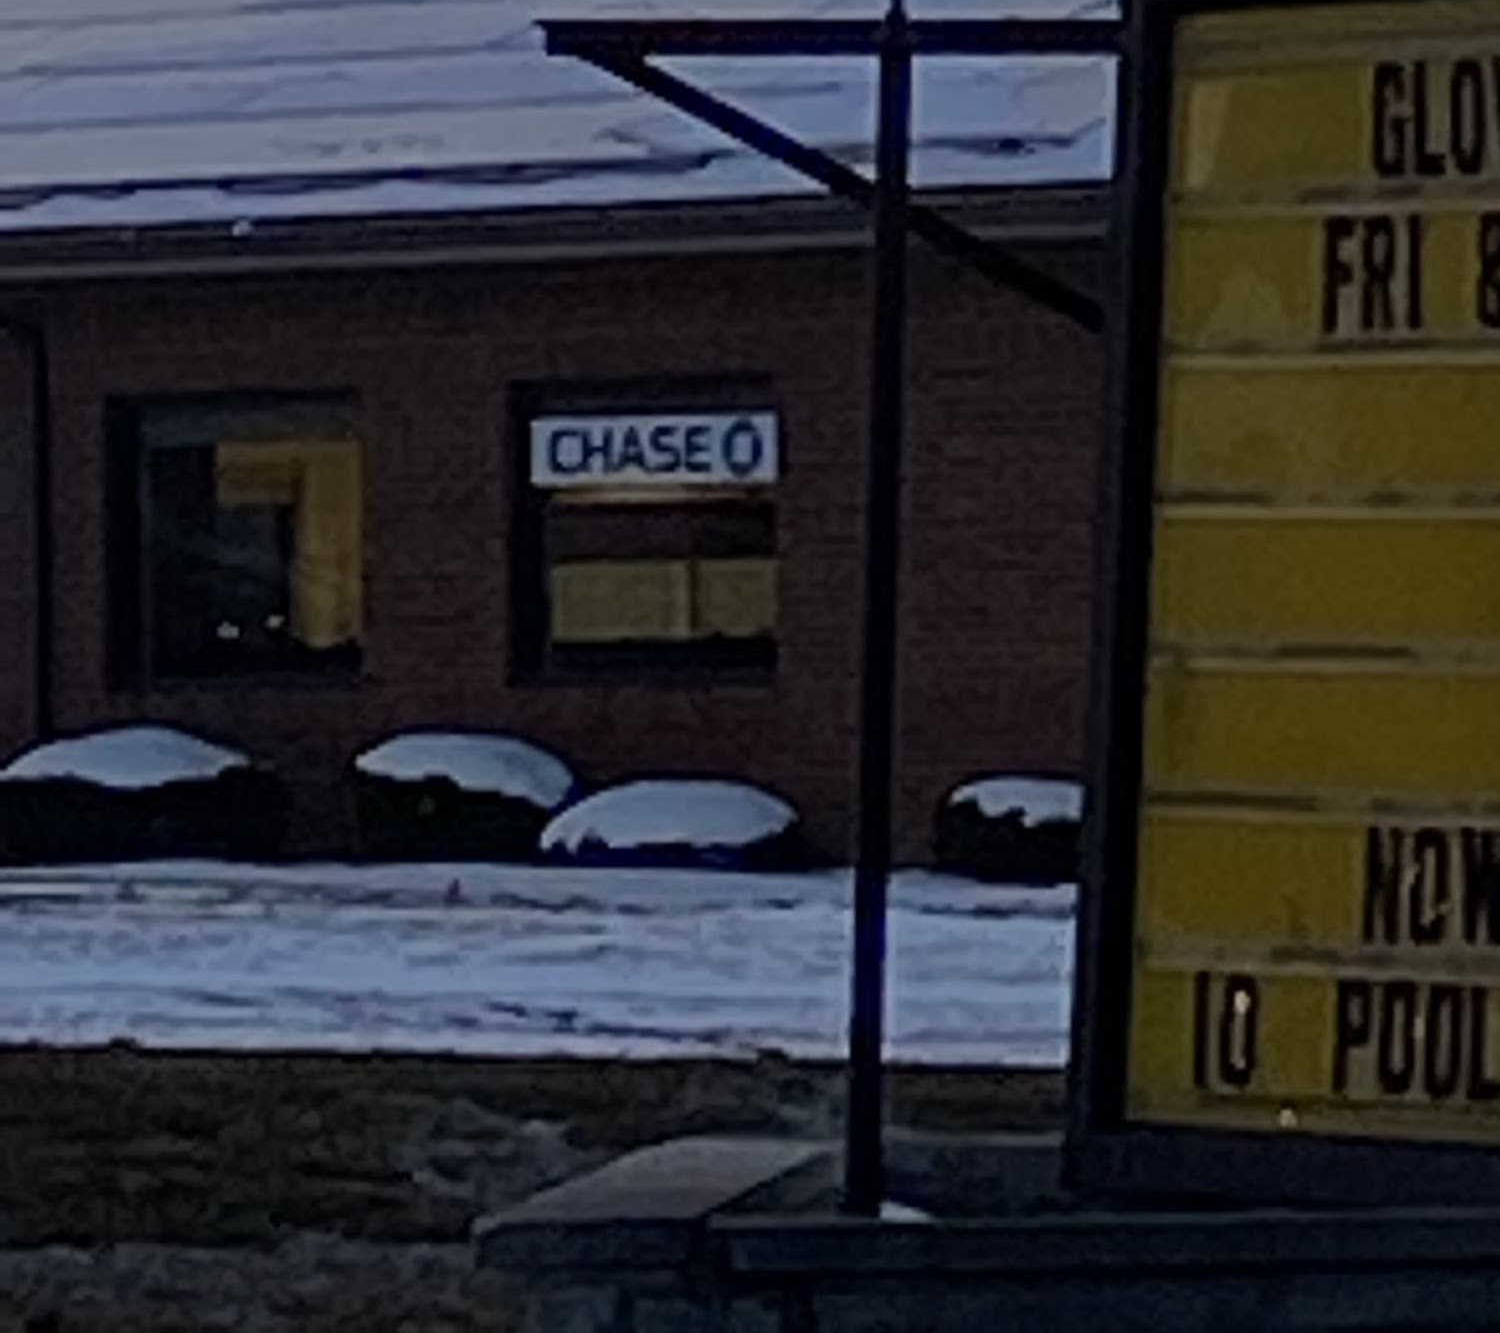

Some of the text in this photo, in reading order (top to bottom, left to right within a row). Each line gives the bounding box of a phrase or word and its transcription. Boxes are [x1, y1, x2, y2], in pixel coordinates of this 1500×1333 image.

[1322, 215, 1424, 332] FRI
[549, 425, 712, 473] CHASE
[1194, 971, 1260, 1088] 10
